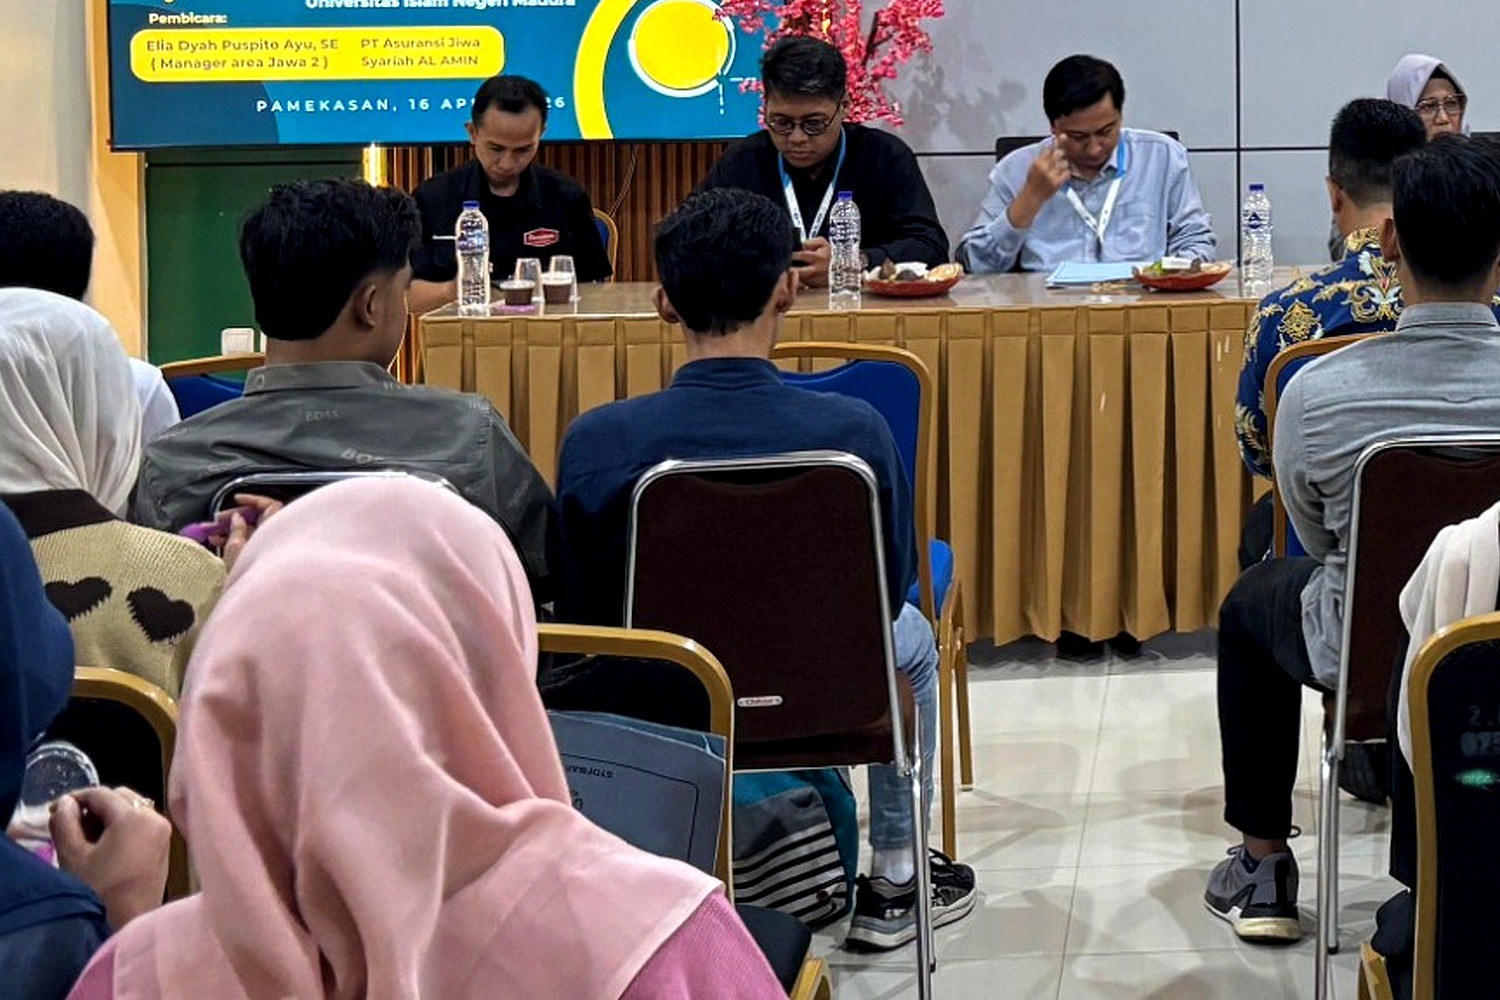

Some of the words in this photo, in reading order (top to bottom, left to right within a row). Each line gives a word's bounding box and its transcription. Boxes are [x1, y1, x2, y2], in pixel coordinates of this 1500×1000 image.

[149, 12, 228, 24] Pembicara:
[147, 39, 173, 52] Elia
[178, 39, 217, 54] Dyah
[222, 38, 279, 54] Puspito
[284, 39, 317, 53] Ayu,
[320, 38, 339, 49] SE
[361, 38, 379, 49] PT
[383, 37, 445, 48] Asuransi
[449, 37, 481, 48] Jiwa
[160, 58, 226, 71] Manager
[231, 58, 264, 68] area
[268, 57, 307, 68] Jawa
[311, 57, 320, 68] 2
[361, 56, 414, 68] Syariah
[418, 56, 436, 66] AL
[440, 56, 479, 66] AMIN
[257, 98, 397, 112] PAMEKASAN,
[408, 98, 430, 110] 16
